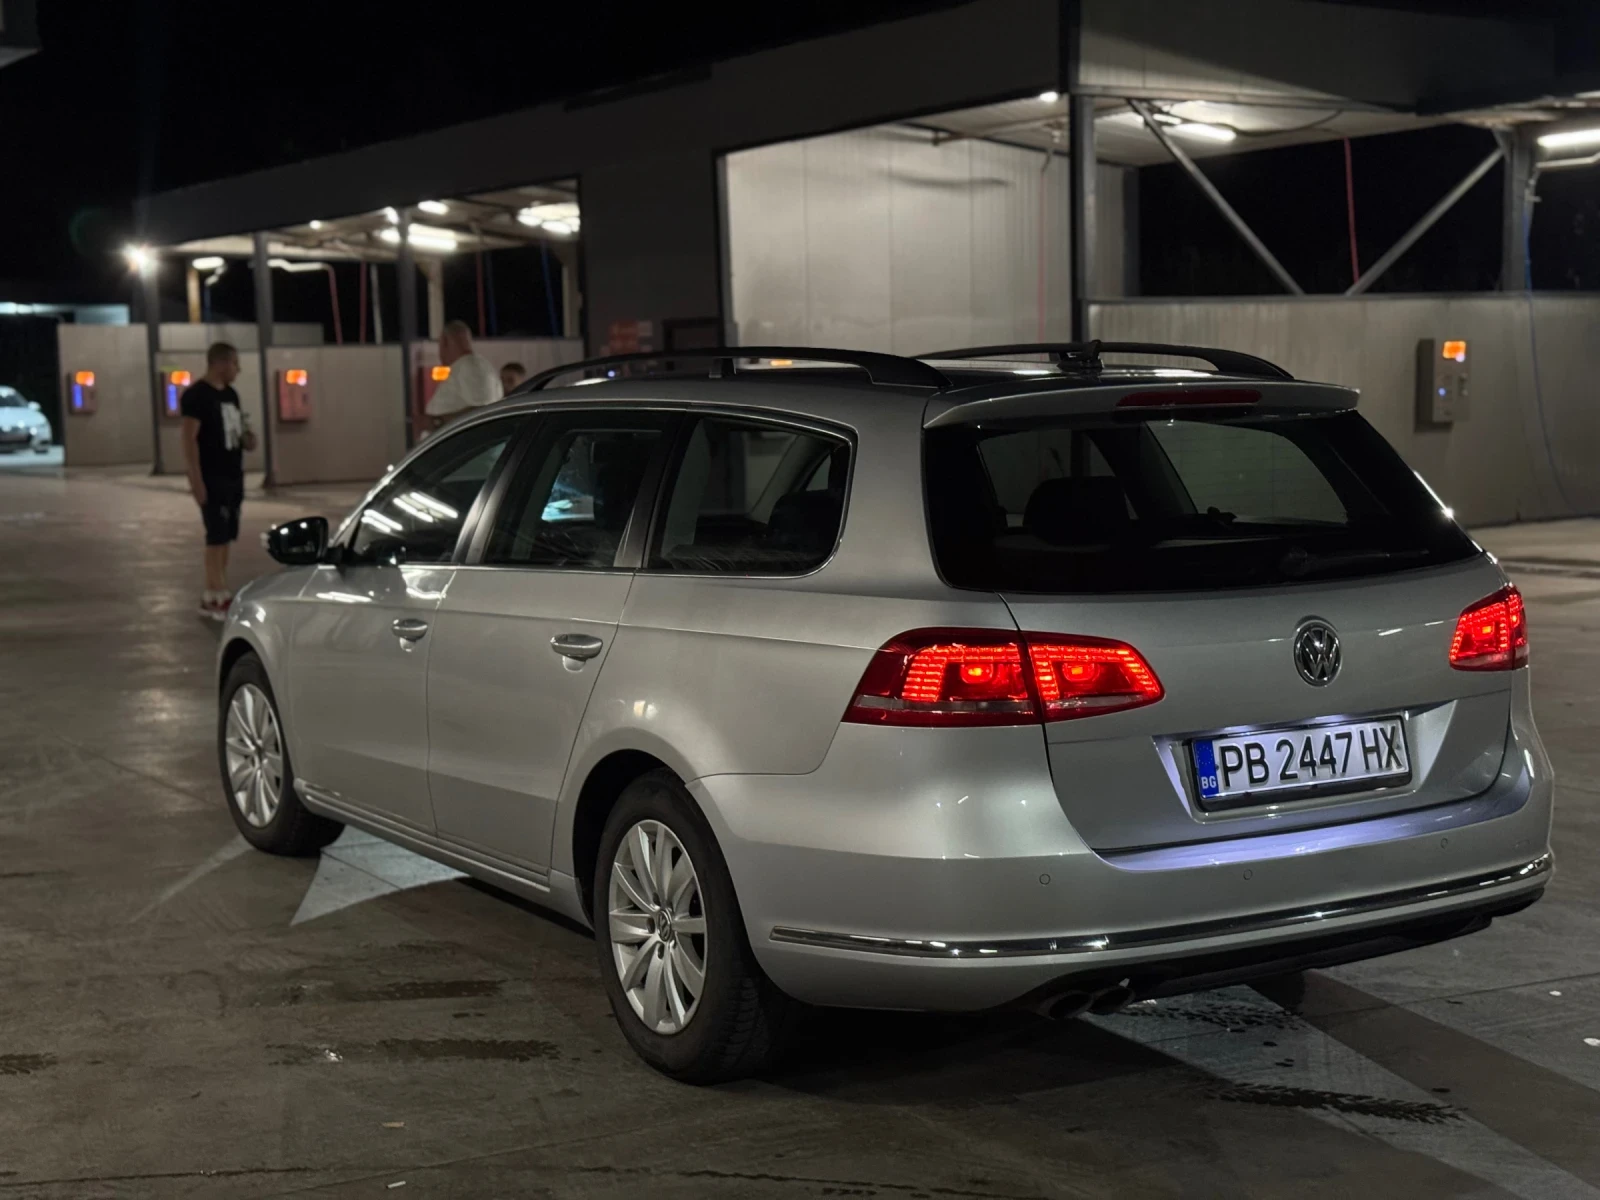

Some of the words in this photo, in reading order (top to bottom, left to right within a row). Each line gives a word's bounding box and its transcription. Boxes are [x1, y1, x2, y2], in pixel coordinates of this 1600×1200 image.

[1296, 621, 1340, 684] VW
[1201, 776, 1217, 789] BG
[1220, 743, 1269, 787] PB
[1276, 732, 1352, 781] 2447
[1360, 726, 1404, 770] HX
